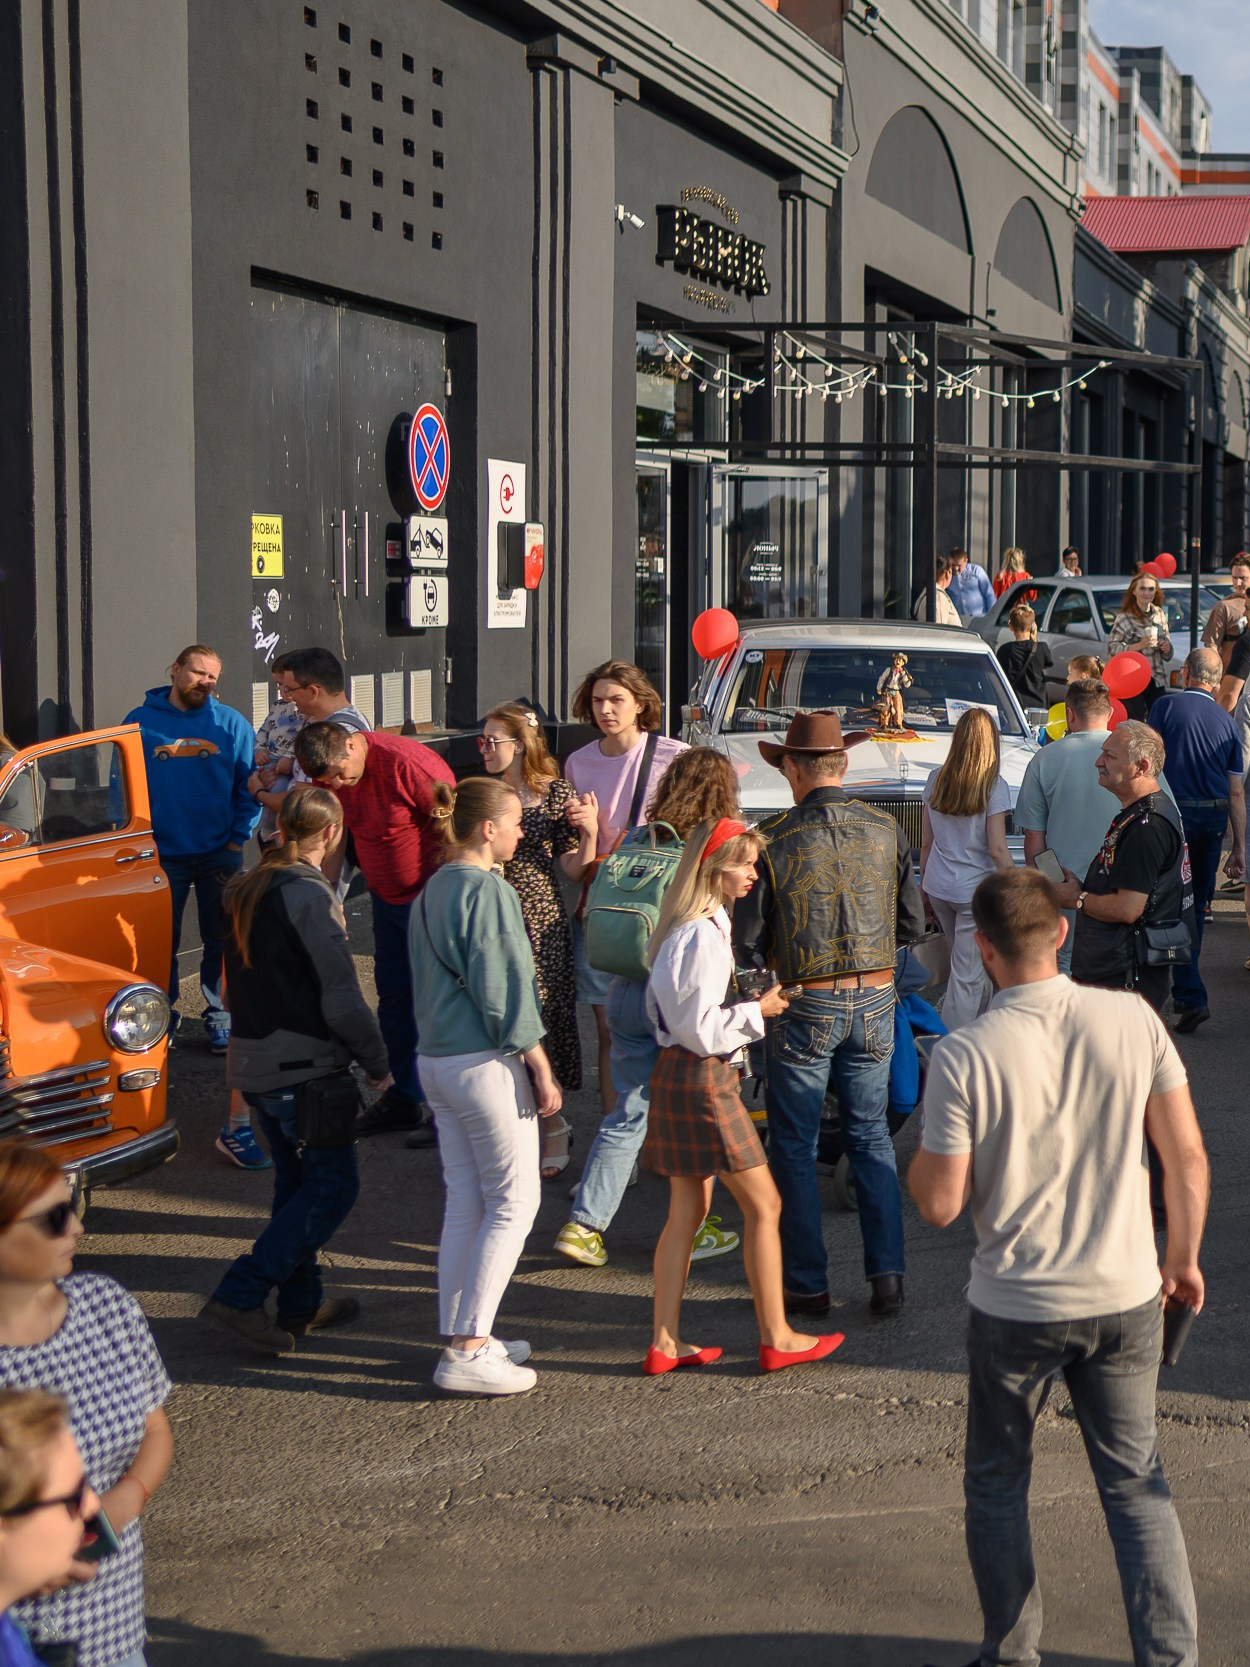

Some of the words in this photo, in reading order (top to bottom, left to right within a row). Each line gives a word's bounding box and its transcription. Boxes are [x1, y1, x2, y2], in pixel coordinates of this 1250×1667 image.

[664, 205, 771, 298] РЫНОК
[252, 541, 282, 554] РЕЩЕНА
[421, 615, 439, 626] КРОМЕ
